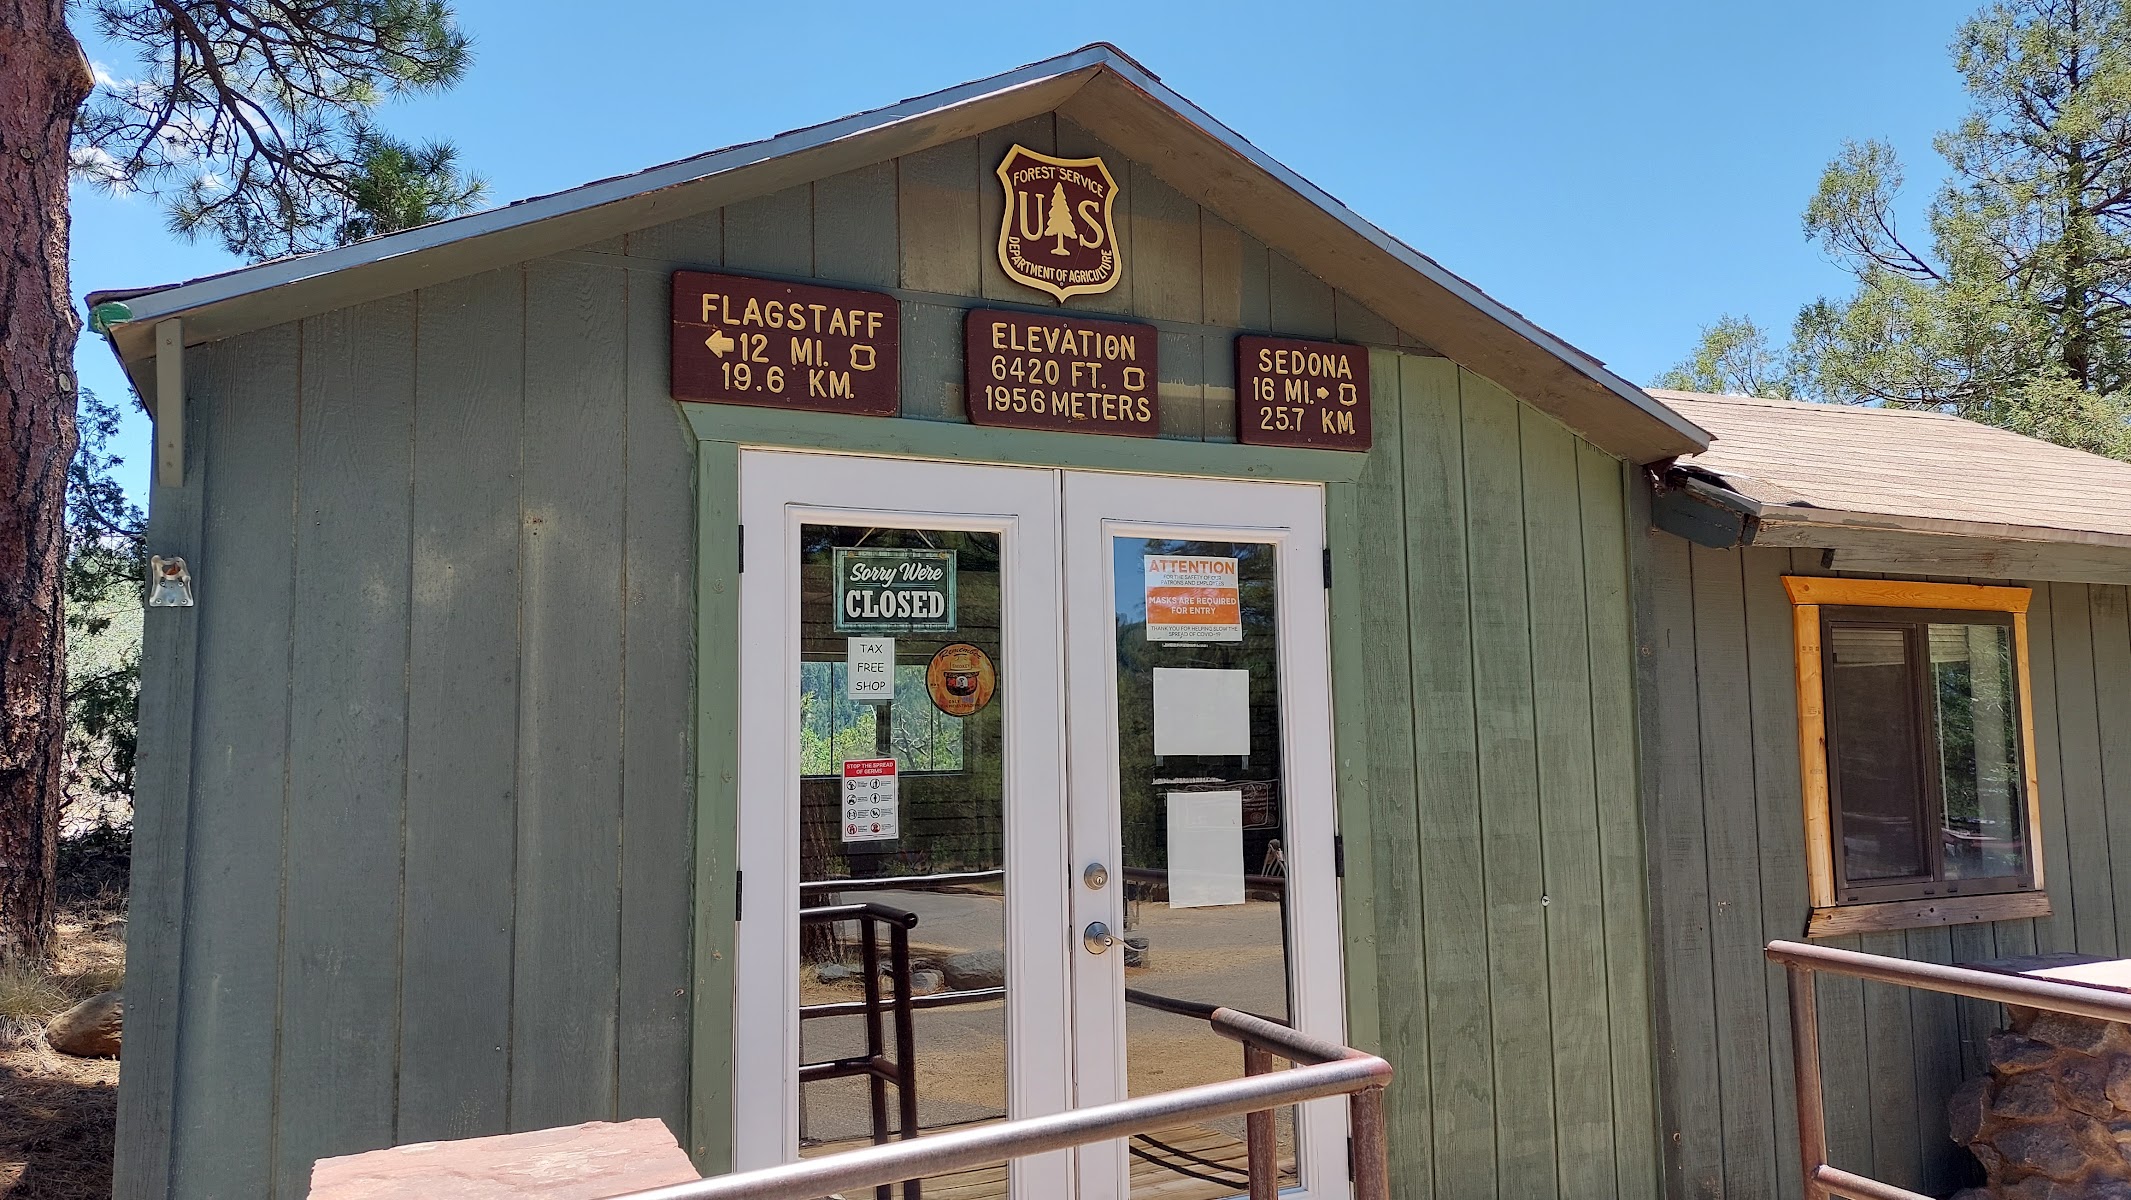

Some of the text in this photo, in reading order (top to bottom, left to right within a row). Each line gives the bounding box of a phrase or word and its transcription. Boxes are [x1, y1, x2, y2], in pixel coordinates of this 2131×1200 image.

[1013, 166, 1104, 199] FOREST SERVICE
[1018, 190, 1105, 249] U S
[1008, 236, 1113, 284] DEPARTMENT OF AGRICULTURE
[702, 292, 884, 339] FLAGSTAFF
[739, 332, 829, 367] 12 MI.
[991, 322, 1136, 361] ELEVATION
[991, 354, 1107, 390] 6420 FT.
[1258, 348, 1353, 381] SEDONA
[721, 361, 855, 400] 19.6 KM.
[1252, 376, 1315, 405] 16 MI.
[985, 384, 1151, 423] 1956 METERS
[1260, 406, 1305, 432] 25.7
[849, 562, 898, 588] Sorry
[1149, 559, 1235, 574] ATTENTION
[845, 589, 945, 619] CLOSED
[1148, 596, 1237, 606] MASKS ARE REQUIRED
[1171, 606, 1216, 615] FOR ENTRY
[860, 644, 883, 654] TAX
[857, 662, 885, 673] FREE
[855, 681, 886, 691] SHOP
